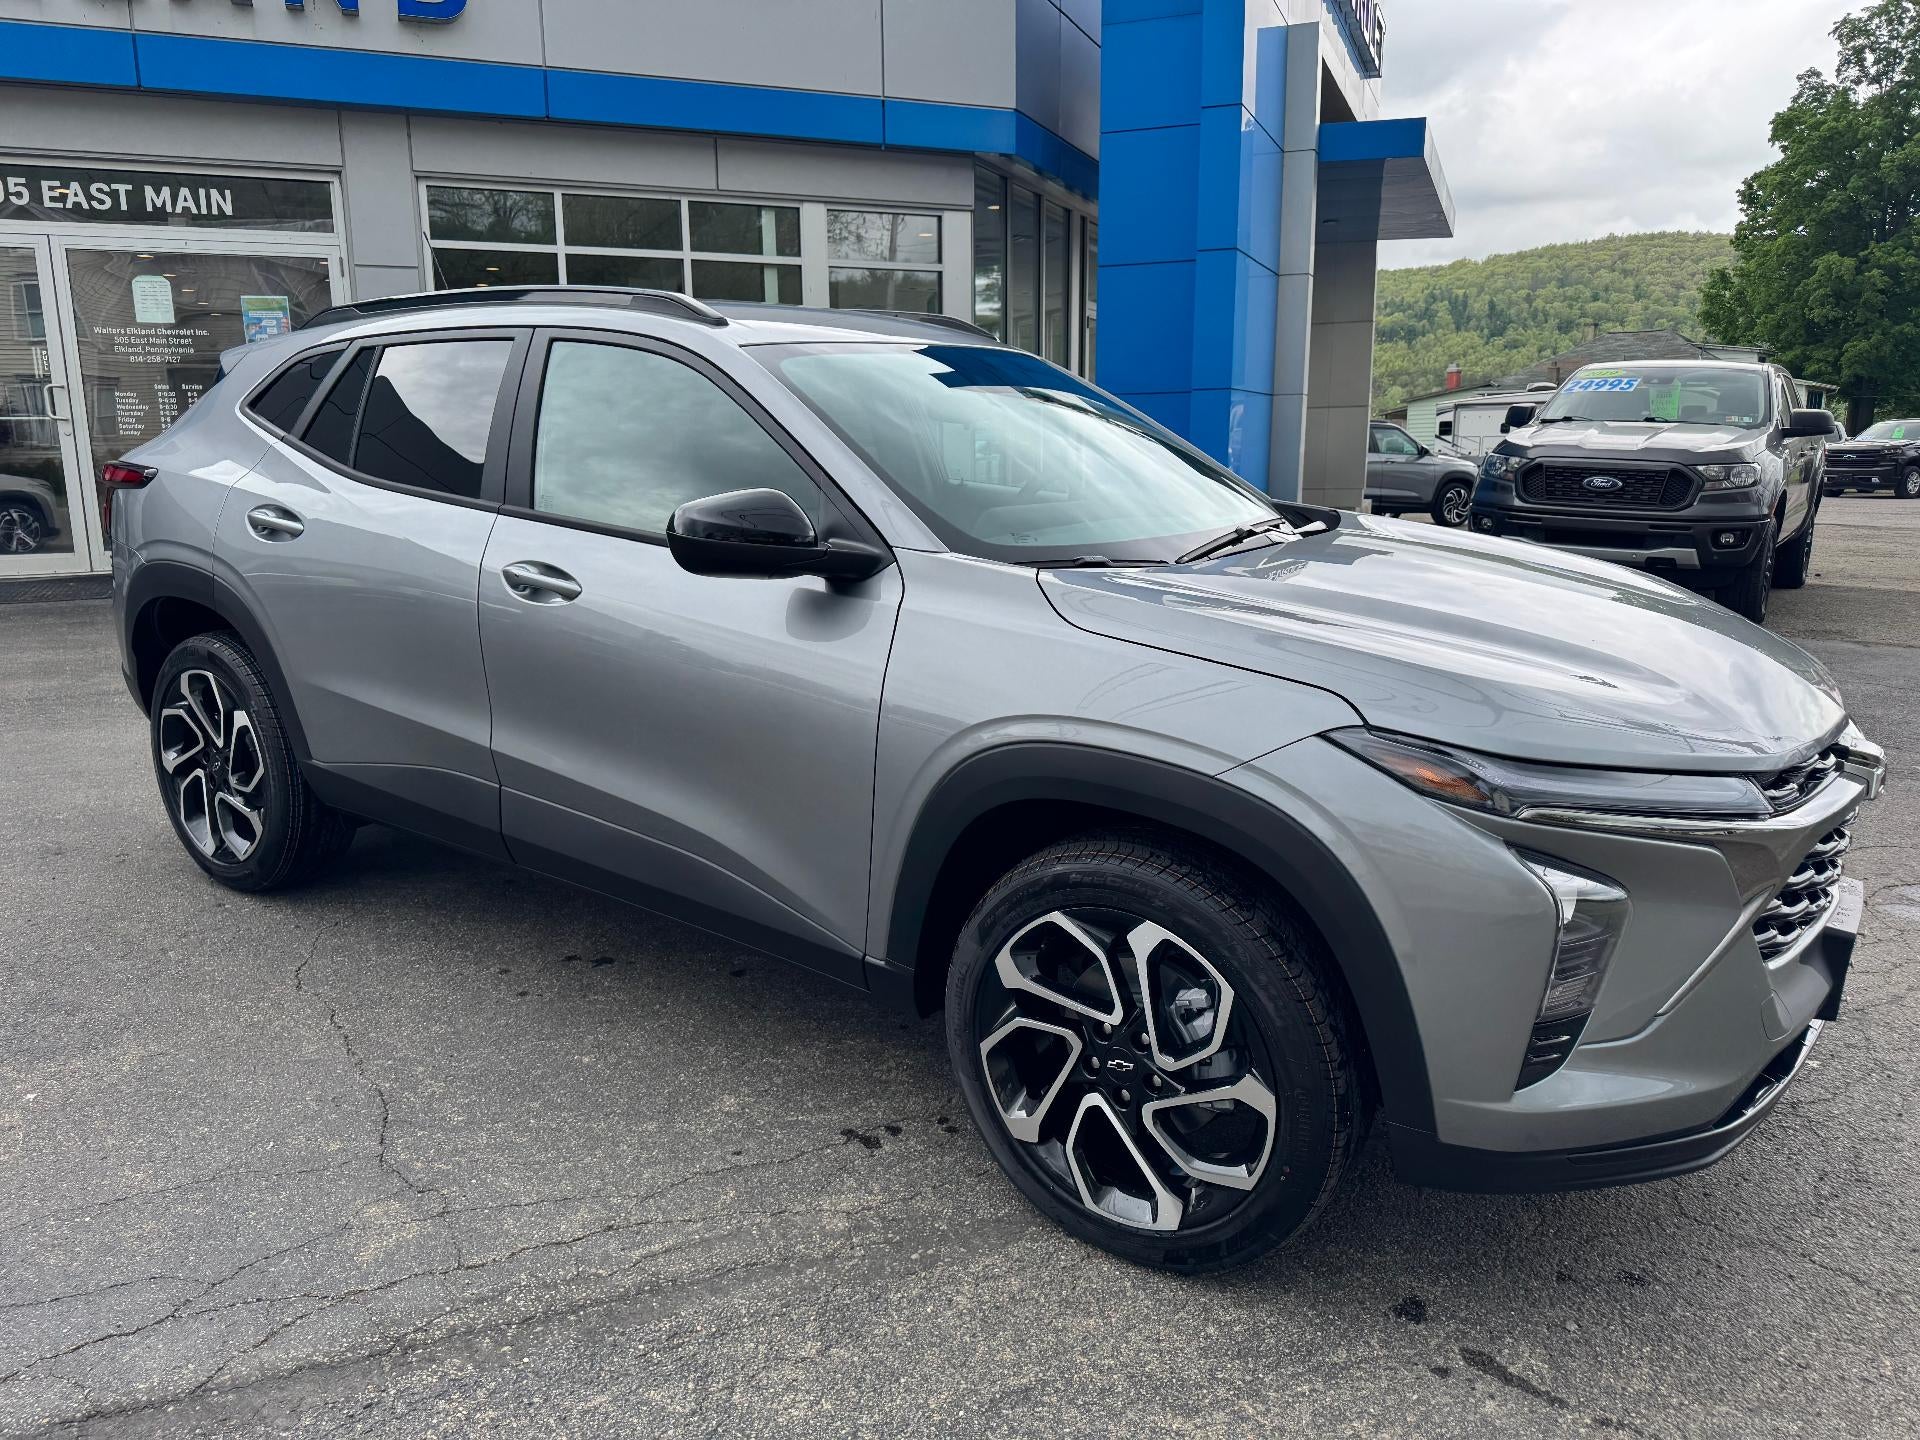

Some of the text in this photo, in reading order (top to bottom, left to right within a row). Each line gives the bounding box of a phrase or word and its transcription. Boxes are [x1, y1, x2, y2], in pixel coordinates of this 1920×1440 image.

[0, 176, 234, 217] 5 EAST MAIN
[93, 326, 210, 336] Walters Elkland Chevrolet Inc.
[114, 336, 129, 344] 505
[168, 337, 193, 345] Street
[114, 345, 195, 355] Elkland, Pennsylvania
[129, 355, 181, 363] 814-258-7127
[1564, 377, 1638, 392] 24995
